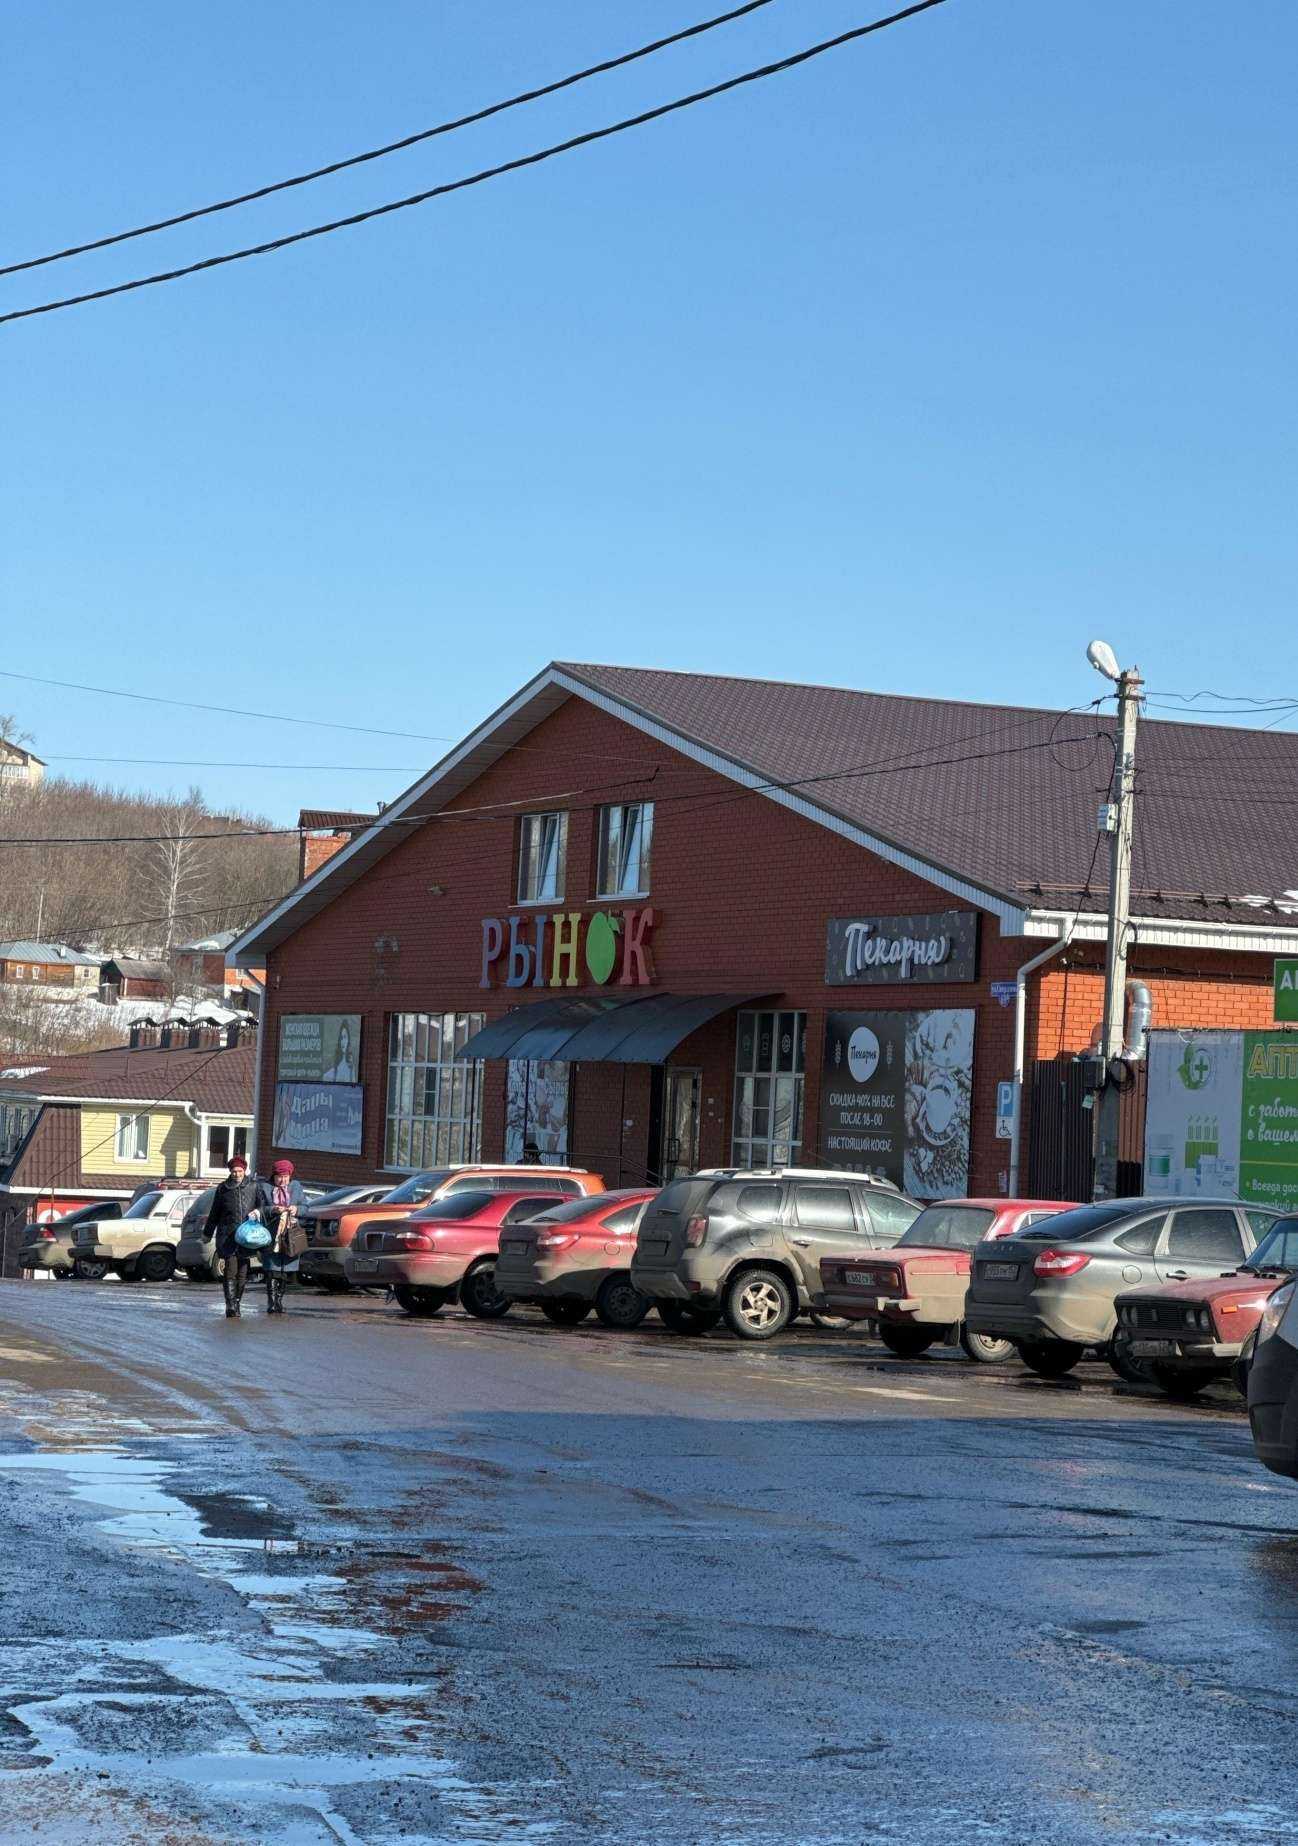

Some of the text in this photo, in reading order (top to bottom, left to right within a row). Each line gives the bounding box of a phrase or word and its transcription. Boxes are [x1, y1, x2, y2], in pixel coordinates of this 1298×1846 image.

[479, 907, 654, 988] РЫНОК
[845, 922, 948, 978] Пекарня
[840, 1112, 862, 1126] ПОСЛЕ
[828, 1136, 893, 1152] НАСТОЯЩИЙ КОФЕ
